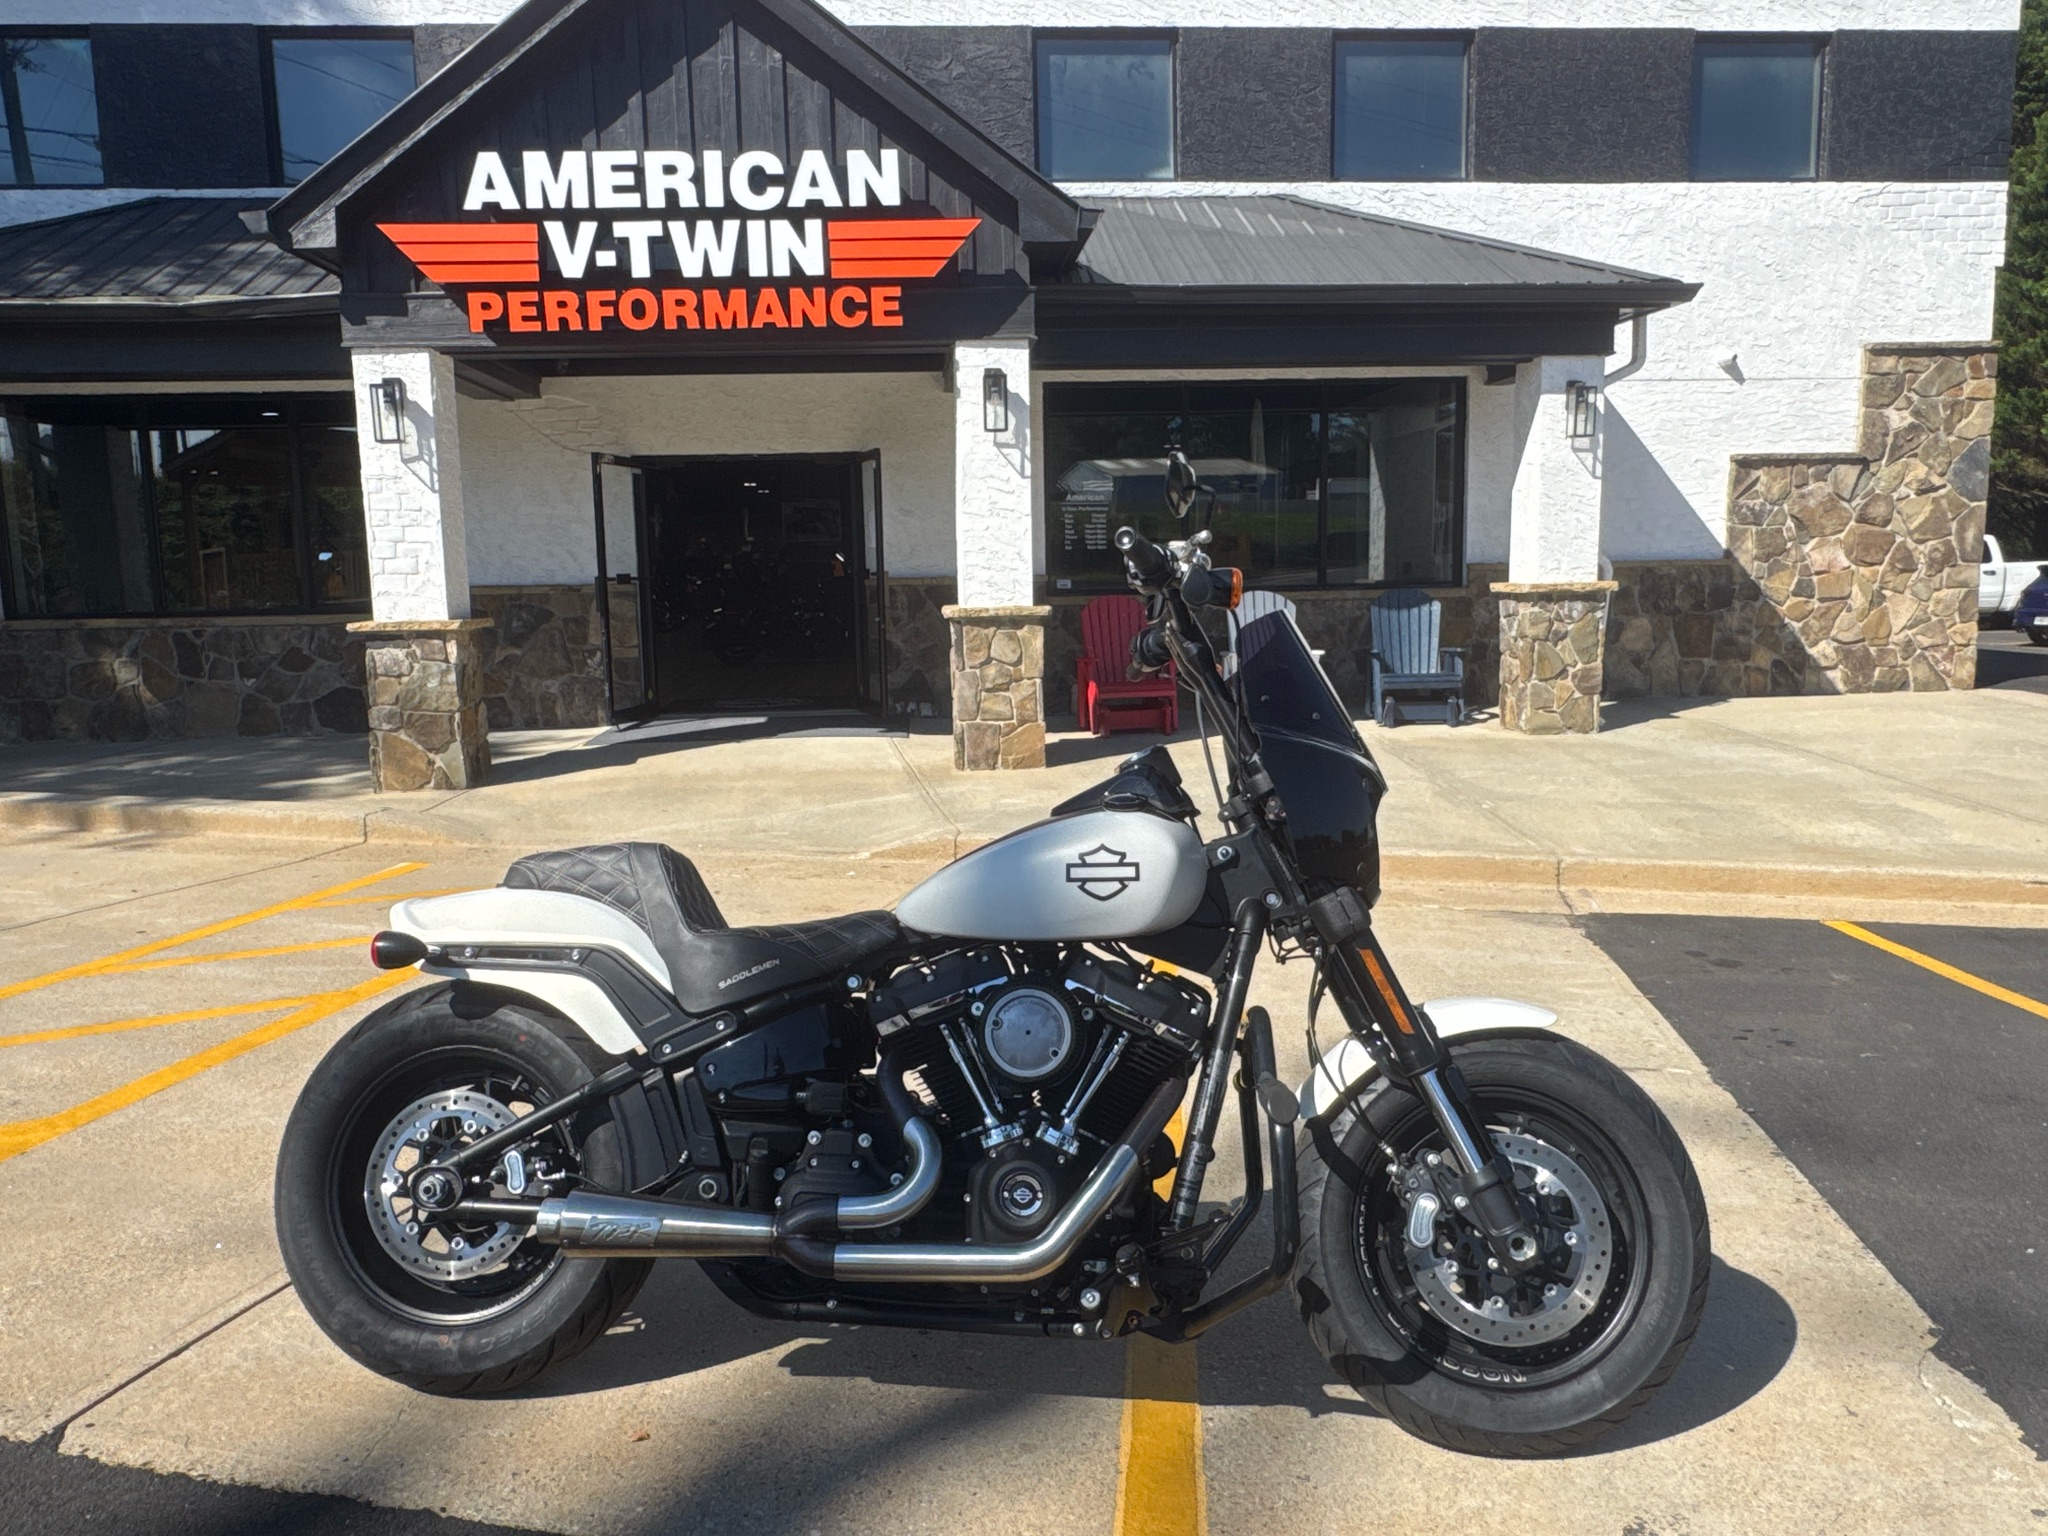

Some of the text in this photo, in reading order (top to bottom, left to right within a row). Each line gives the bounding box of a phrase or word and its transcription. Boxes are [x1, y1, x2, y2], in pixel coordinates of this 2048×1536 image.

[463, 148, 902, 211] AMERICAN
[543, 218, 825, 279] V-TWIN
[467, 286, 904, 333] PERFORMANCE
